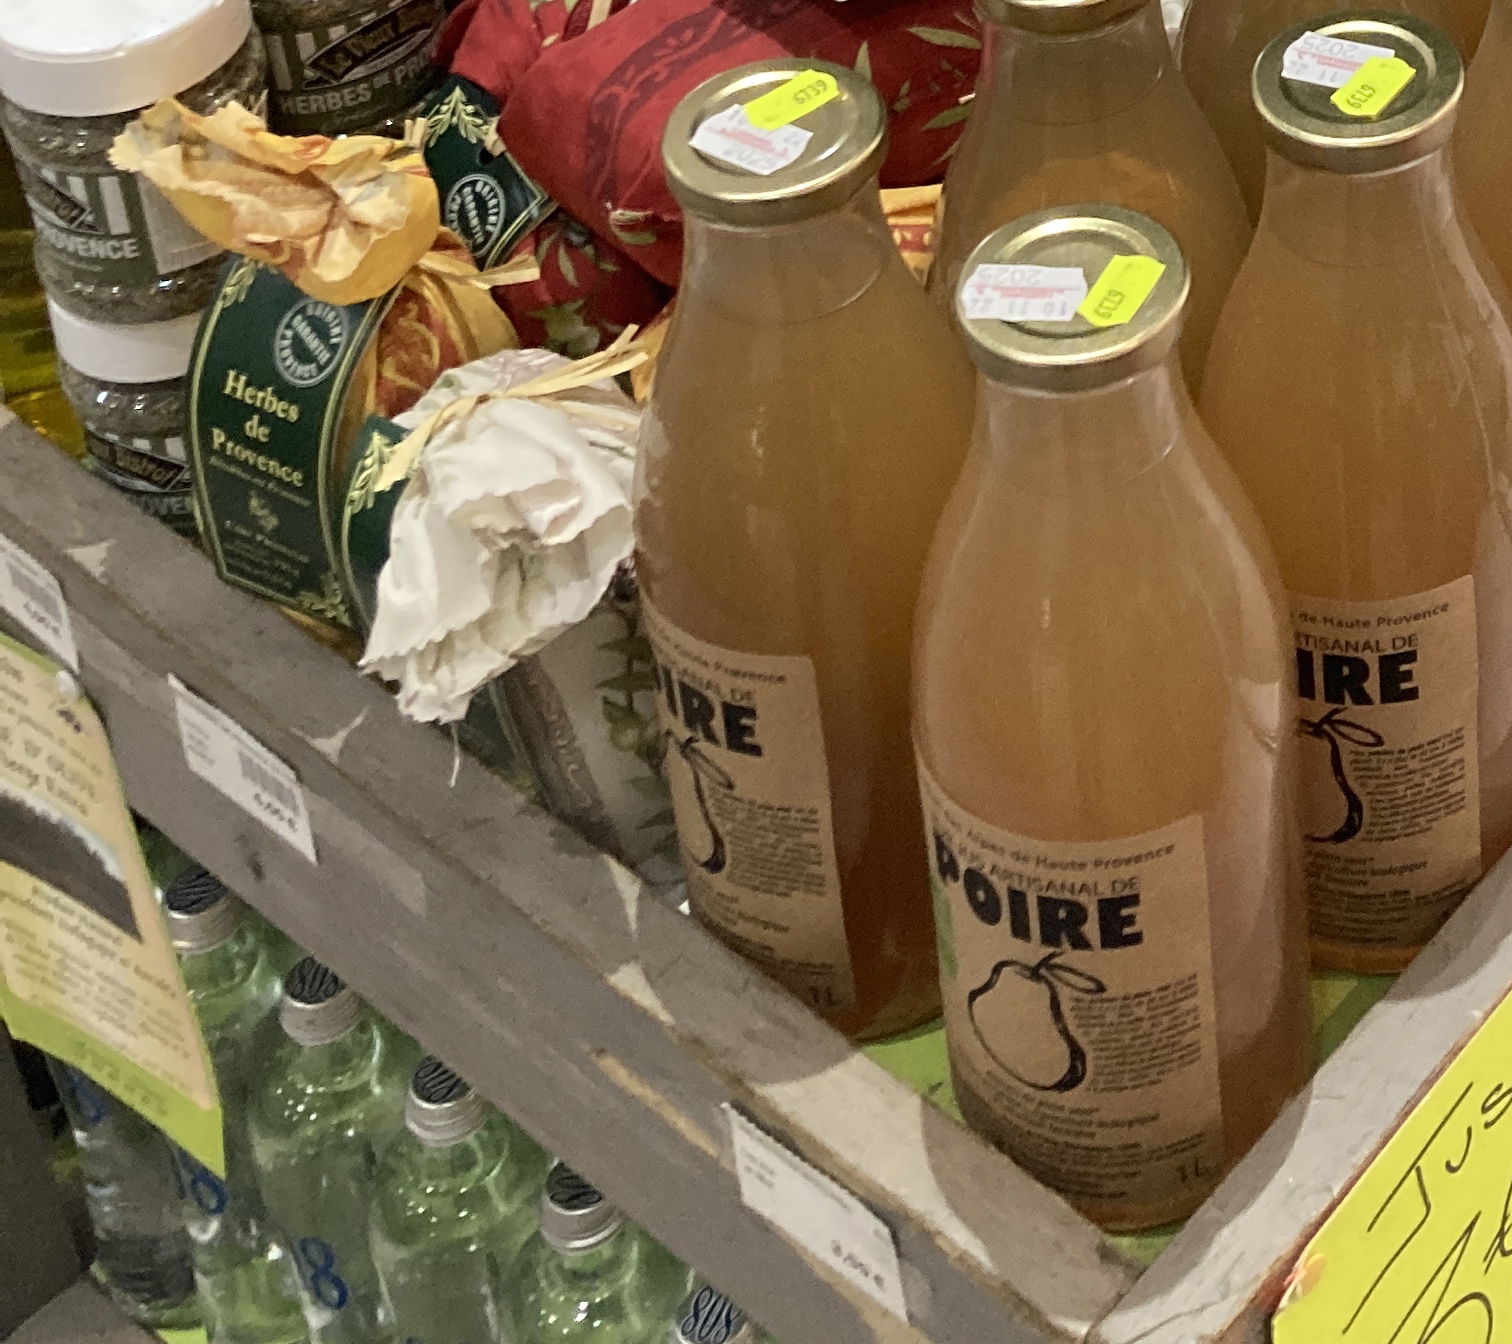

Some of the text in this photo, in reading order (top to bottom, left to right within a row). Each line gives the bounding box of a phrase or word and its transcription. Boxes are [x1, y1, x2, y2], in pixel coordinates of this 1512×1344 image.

[223, 368, 300, 424] Herbes
[243, 414, 272, 443] de
[210, 426, 305, 488] Provence
[1323, 613, 1373, 630] Haute
[1375, 601, 1451, 629] Provence
[1391, 633, 1420, 651] DE
[1035, 854, 1088, 873] Haute
[1093, 841, 1177, 871] Provence
[1111, 875, 1140, 895] DE
